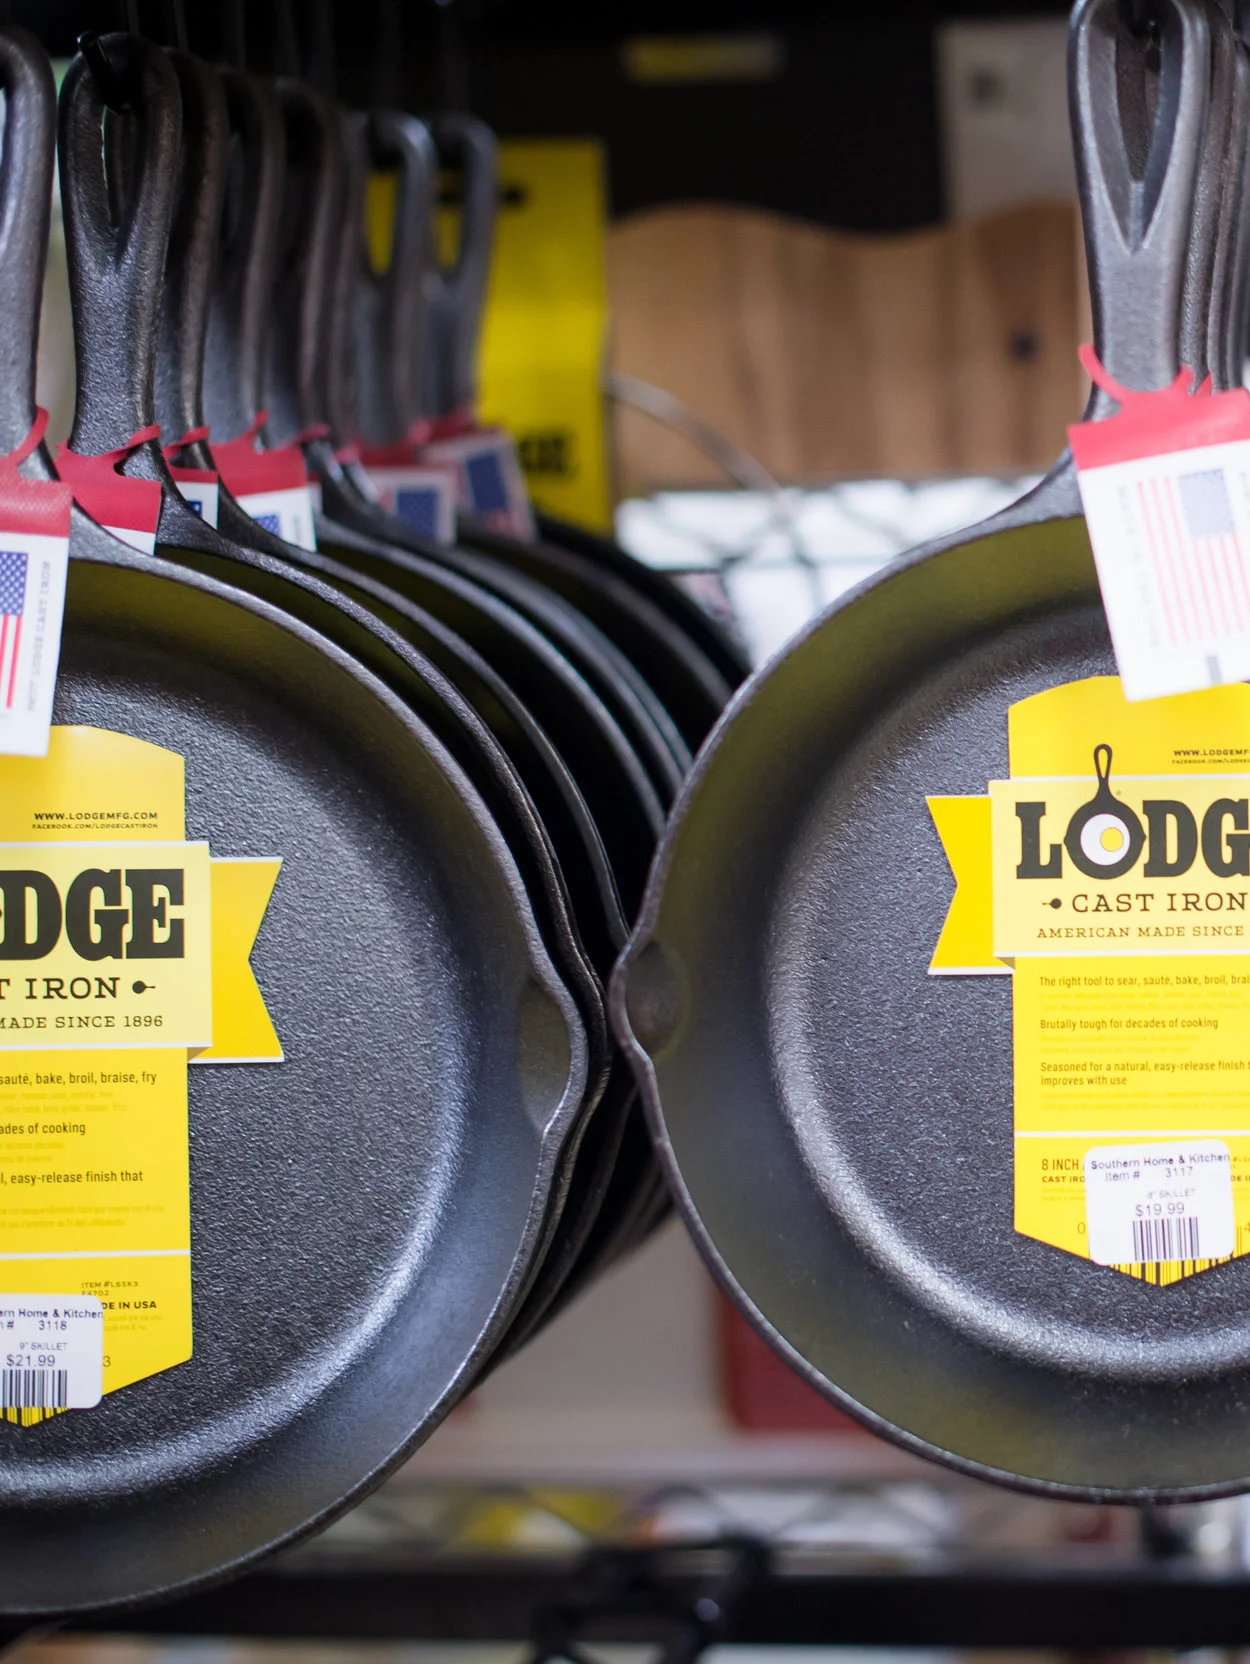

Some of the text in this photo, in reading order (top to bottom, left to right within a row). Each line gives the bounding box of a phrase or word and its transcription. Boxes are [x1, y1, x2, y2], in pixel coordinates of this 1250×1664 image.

[34, 812, 158, 821] WWW.LODGEMFG.COM
[32, 822, 158, 830] FACEBOOK.COM/LODGECASTIRON
[1072, 893, 1249, 913] CAST IRON
[0, 868, 185, 962] DGE
[1037, 927, 1130, 939] AMERICAN
[1138, 926, 1186, 938] MADE
[1193, 926, 1247, 938] SINCE
[1040, 976, 1056, 986] The
[1059, 976, 1081, 988] right
[1084, 976, 1102, 986] tool
[1105, 976, 1114, 986] to
[1117, 977, 1140, 987] sear,
[1143, 975, 1173, 987] sauté,
[1176, 975, 1202, 986] bake,
[1204, 974, 1228, 986] broil,
[25, 977, 120, 1000] IRON
[55, 1016, 116, 1029] SINCE
[124, 1015, 163, 1028] 1896
[1040, 1018, 1219, 1031] Brutally tough for decades of cooking
[1040, 1061, 1087, 1072] Seasoned
[1090, 1061, 1103, 1072] for
[1106, 1063, 1111, 1071] a
[1114, 1060, 1151, 1072] natural,
[1154, 1060, 1215, 1073] easy-release
[1218, 1060, 1245, 1071] finish
[35, 1072, 66, 1085] bake,
[69, 1071, 98, 1085] broil,
[100, 1071, 139, 1084] braise,
[142, 1071, 157, 1086] fry
[1087, 1075, 1107, 1085] with
[1110, 1076, 1127, 1085] use
[28, 1123, 39, 1134] of
[42, 1122, 86, 1136] cooking
[1041, 1158, 1079, 1171] 8 INCH
[1091, 1153, 1230, 1170] Southern Home & Kitchen
[10, 1172, 83, 1186] easy-release
[86, 1171, 118, 1183] finish
[120, 1171, 143, 1182] that
[1042, 1175, 1066, 1183] CAST
[1105, 1166, 1193, 1182] Item # 3117
[81, 1281, 102, 1289] ITEM
[118, 1302, 130, 1310] IN
[134, 1301, 157, 1309] USA
[18, 1308, 49, 1318] Home
[52, 1309, 60, 1318] &
[64, 1308, 104, 1319] Kitchen
[6, 1321, 14, 1329] #
[38, 1320, 68, 1331] 3118
[30, 1342, 68, 1351] SKILLET
[6, 1354, 56, 1368] $21.99
